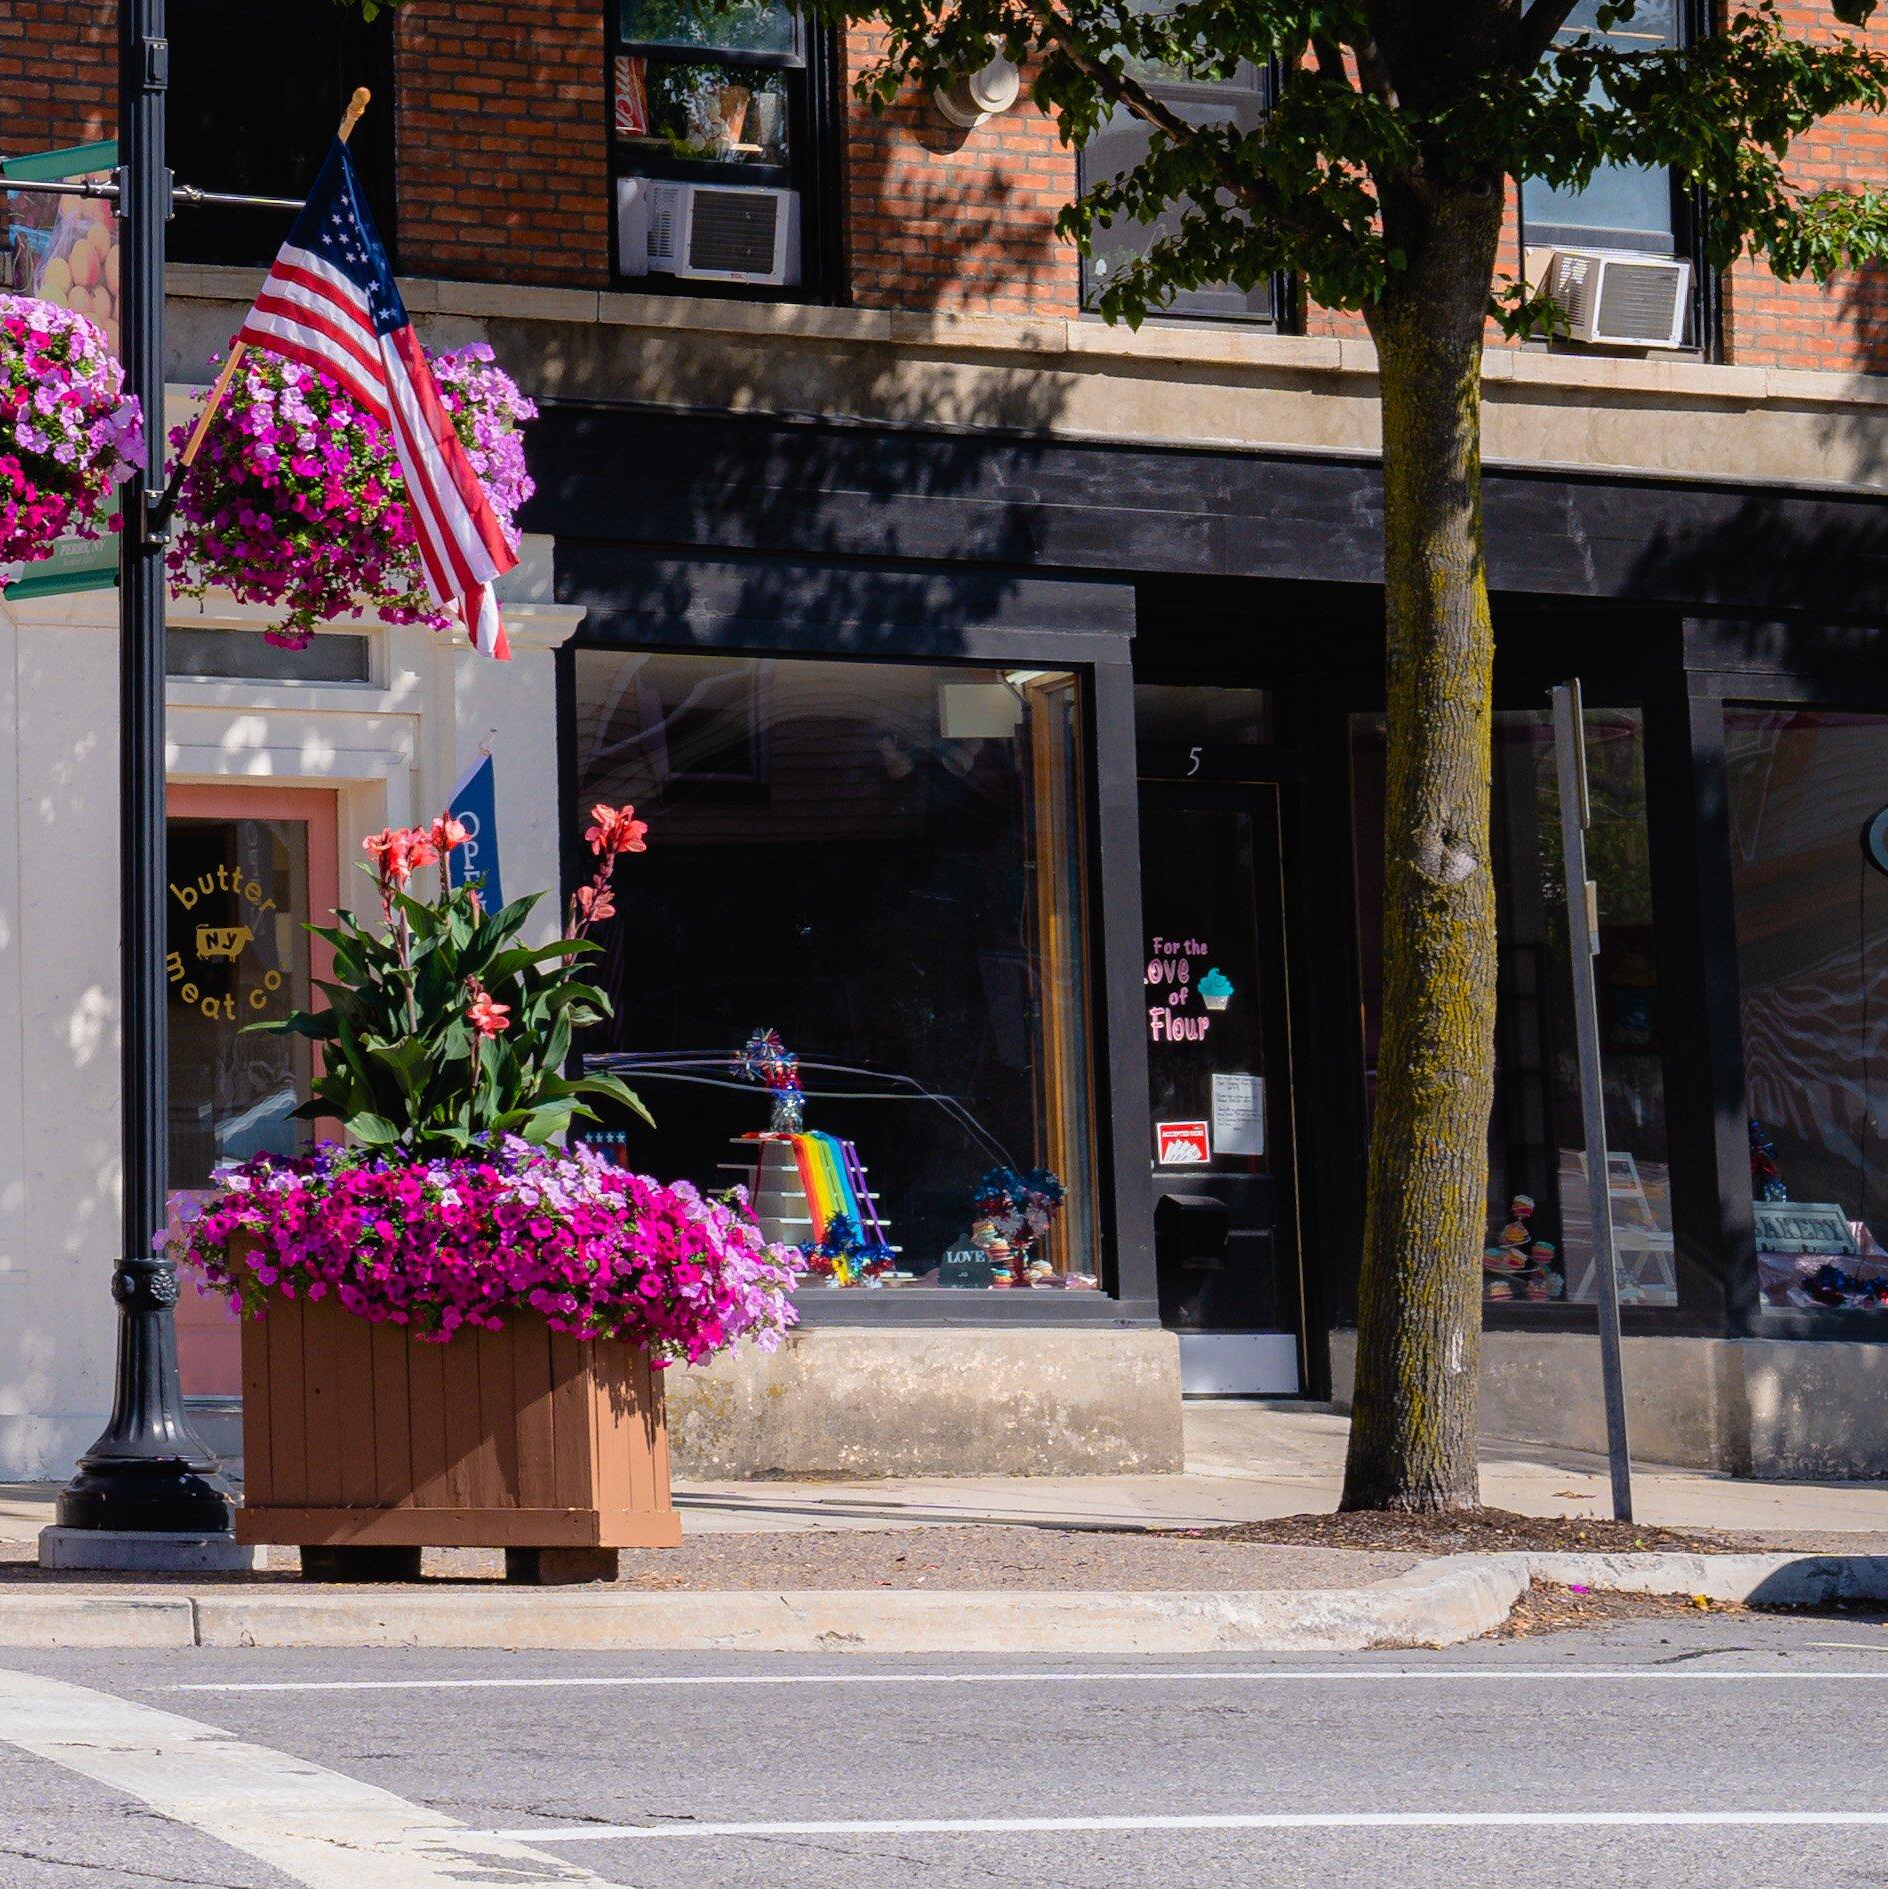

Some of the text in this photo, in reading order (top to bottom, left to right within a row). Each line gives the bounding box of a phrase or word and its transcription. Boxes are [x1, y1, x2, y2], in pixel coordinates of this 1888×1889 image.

[1186, 746, 1203, 776] 5
[169, 864, 277, 911] butter
[1152, 936, 1209, 956] For the
[165, 951, 237, 1021] meat
[1168, 986, 1189, 1006] of
[1148, 1006, 1211, 1042] Flour
[1753, 1216, 1844, 1242] AKERY
[945, 1250, 986, 1264] LOVE
